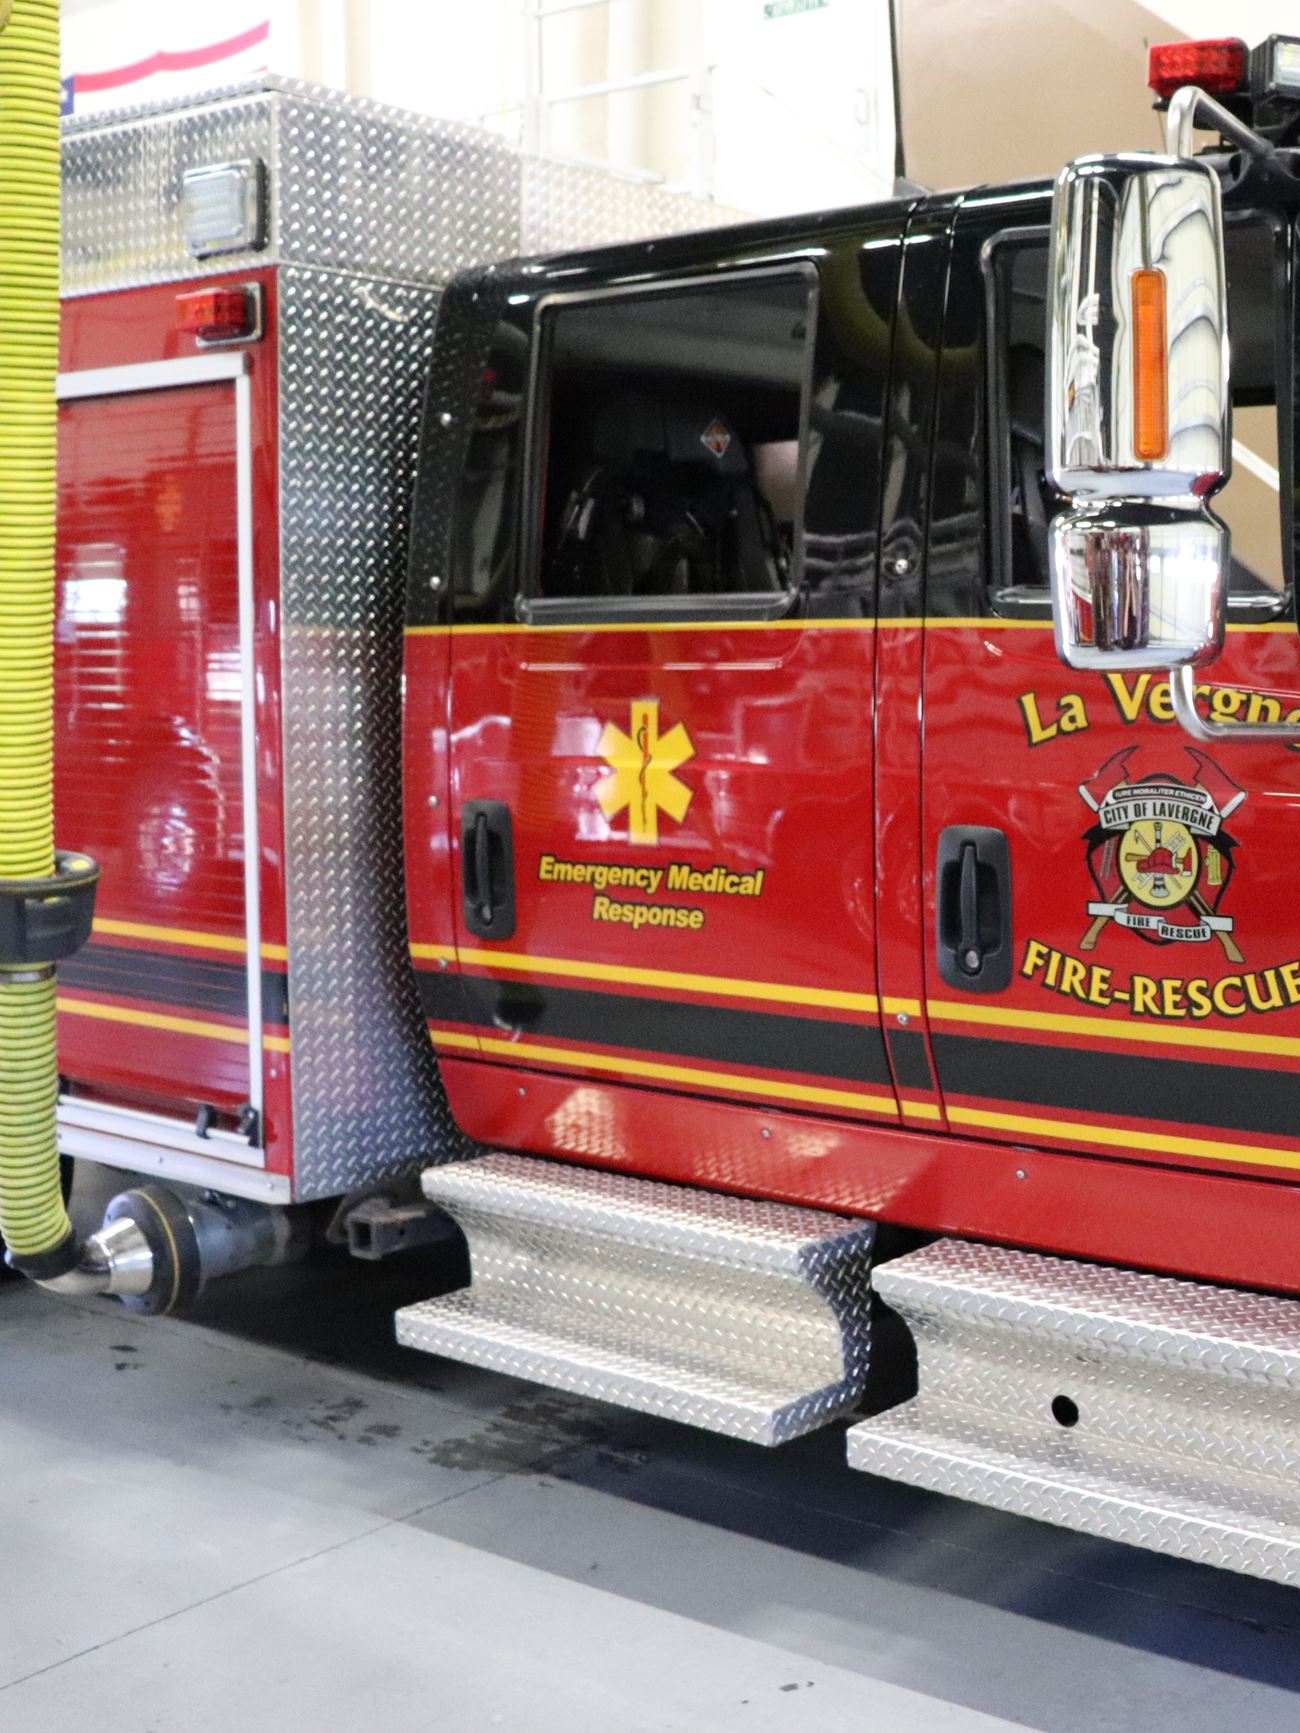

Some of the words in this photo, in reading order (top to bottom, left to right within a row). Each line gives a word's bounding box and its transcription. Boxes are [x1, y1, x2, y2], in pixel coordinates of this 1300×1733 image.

[1018, 690, 1089, 747] La
[1103, 804, 1129, 824] CITY
[1134, 802, 1148, 817] OF
[1153, 802, 1214, 830] LAVERGNE
[538, 853, 663, 895] Emergency
[666, 862, 765, 897] Medical
[592, 893, 705, 930] Response
[1126, 915, 1151, 928] FIRE
[1160, 926, 1208, 939] RESCUE
